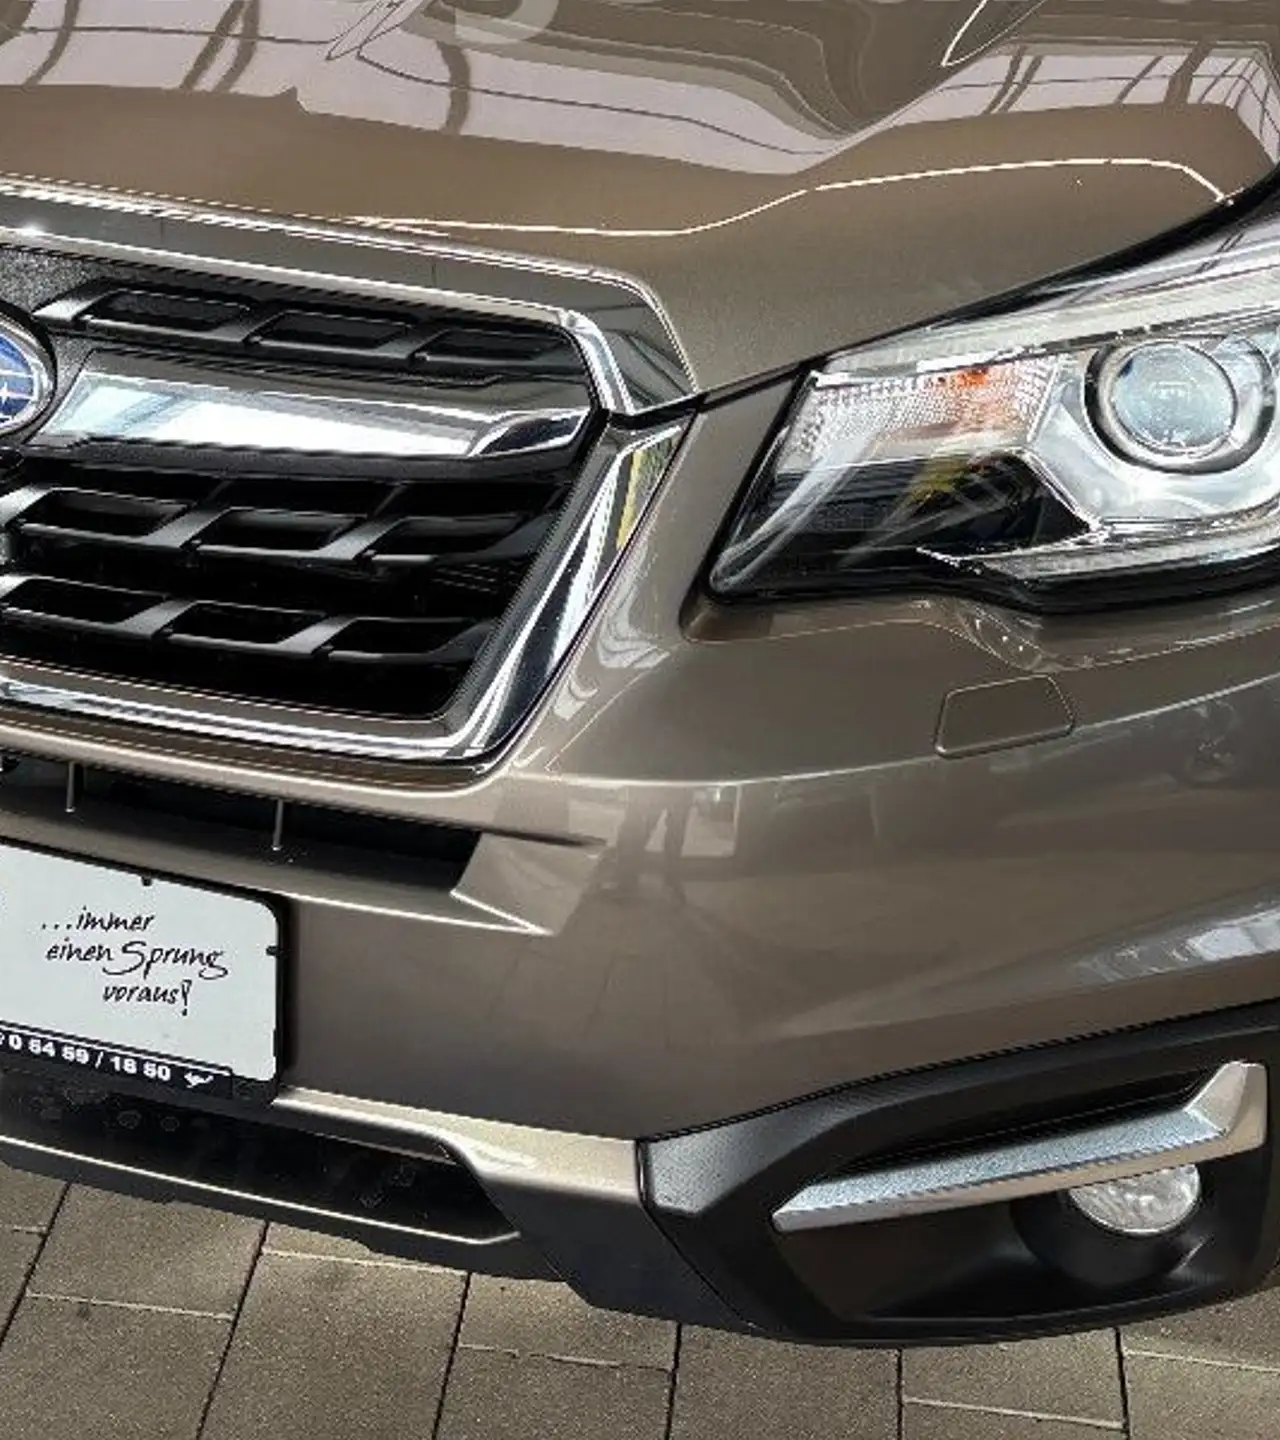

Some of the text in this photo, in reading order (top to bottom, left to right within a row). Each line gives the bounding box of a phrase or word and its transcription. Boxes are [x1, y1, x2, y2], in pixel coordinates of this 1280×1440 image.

[45, 937, 230, 981] einen Sprung
[102, 978, 193, 1016] voraus!
[8, 1033, 23, 1051] 0
